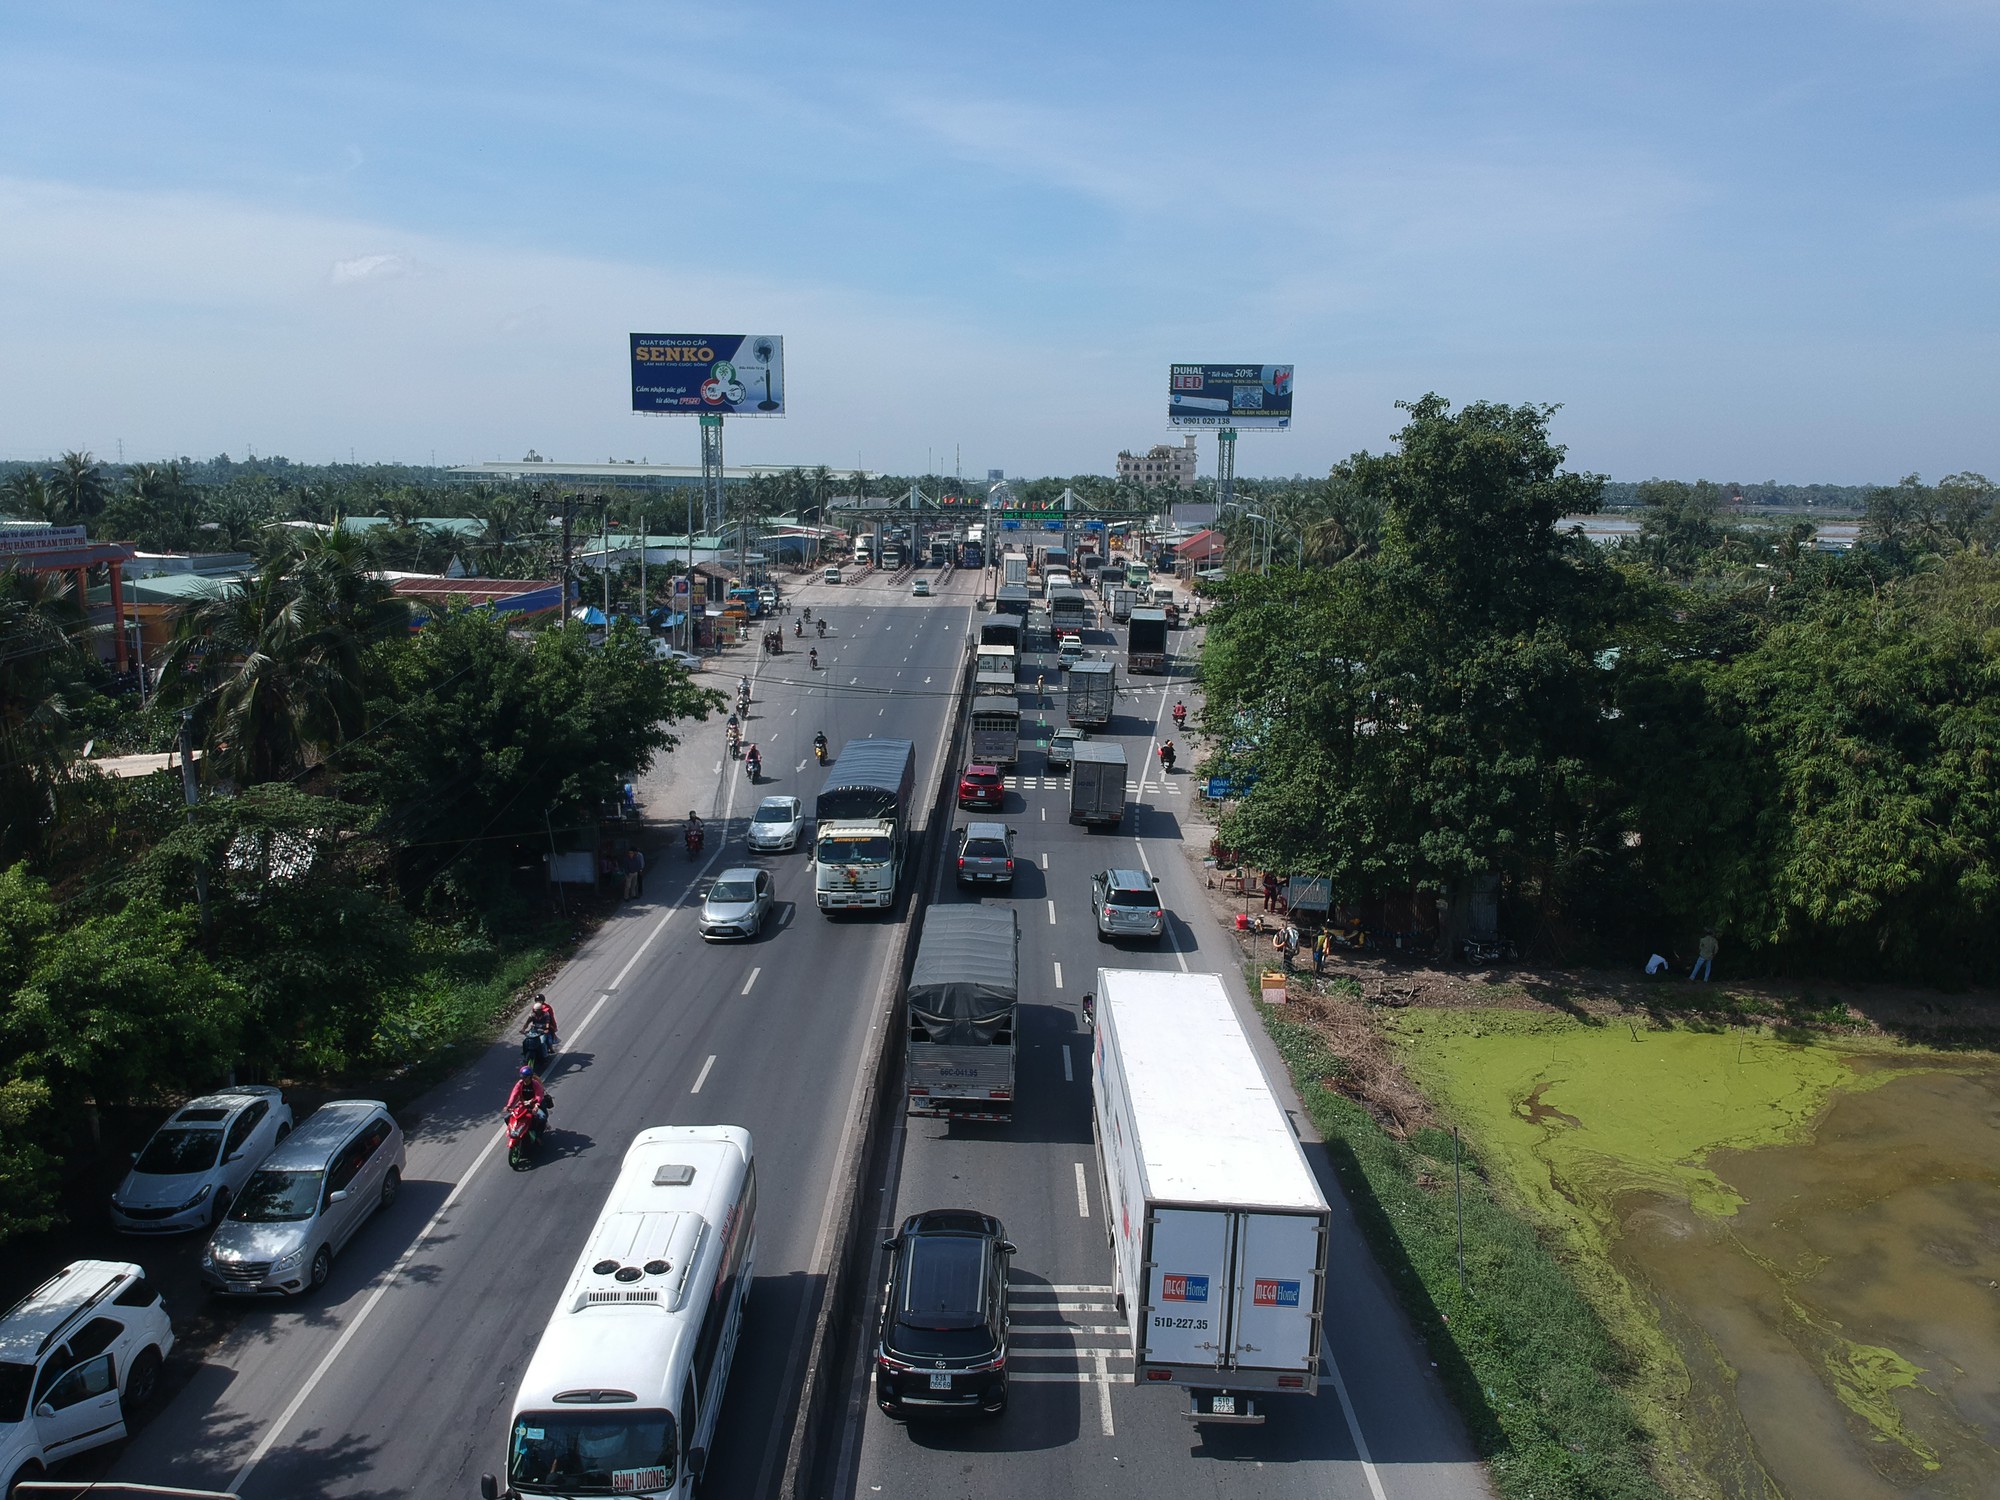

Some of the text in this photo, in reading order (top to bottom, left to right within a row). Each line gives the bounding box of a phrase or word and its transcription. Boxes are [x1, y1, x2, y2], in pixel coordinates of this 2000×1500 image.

[636, 346, 714, 362] SENKO
[1173, 366, 1204, 375] DUHAL
[1234, 368, 1254, 378] 50%
[1174, 376, 1202, 389] LED
[1183, 417, 1230, 425] 0901 020 138
[60, 538, 73, 547] THU
[1164, 1279, 1206, 1297] MEGA Home
[1255, 1284, 1297, 1301] MEGA Home
[1154, 1316, 1208, 1330] 51D-227.35
[614, 1468, 664, 1490] BÌNH DƯƠNG
